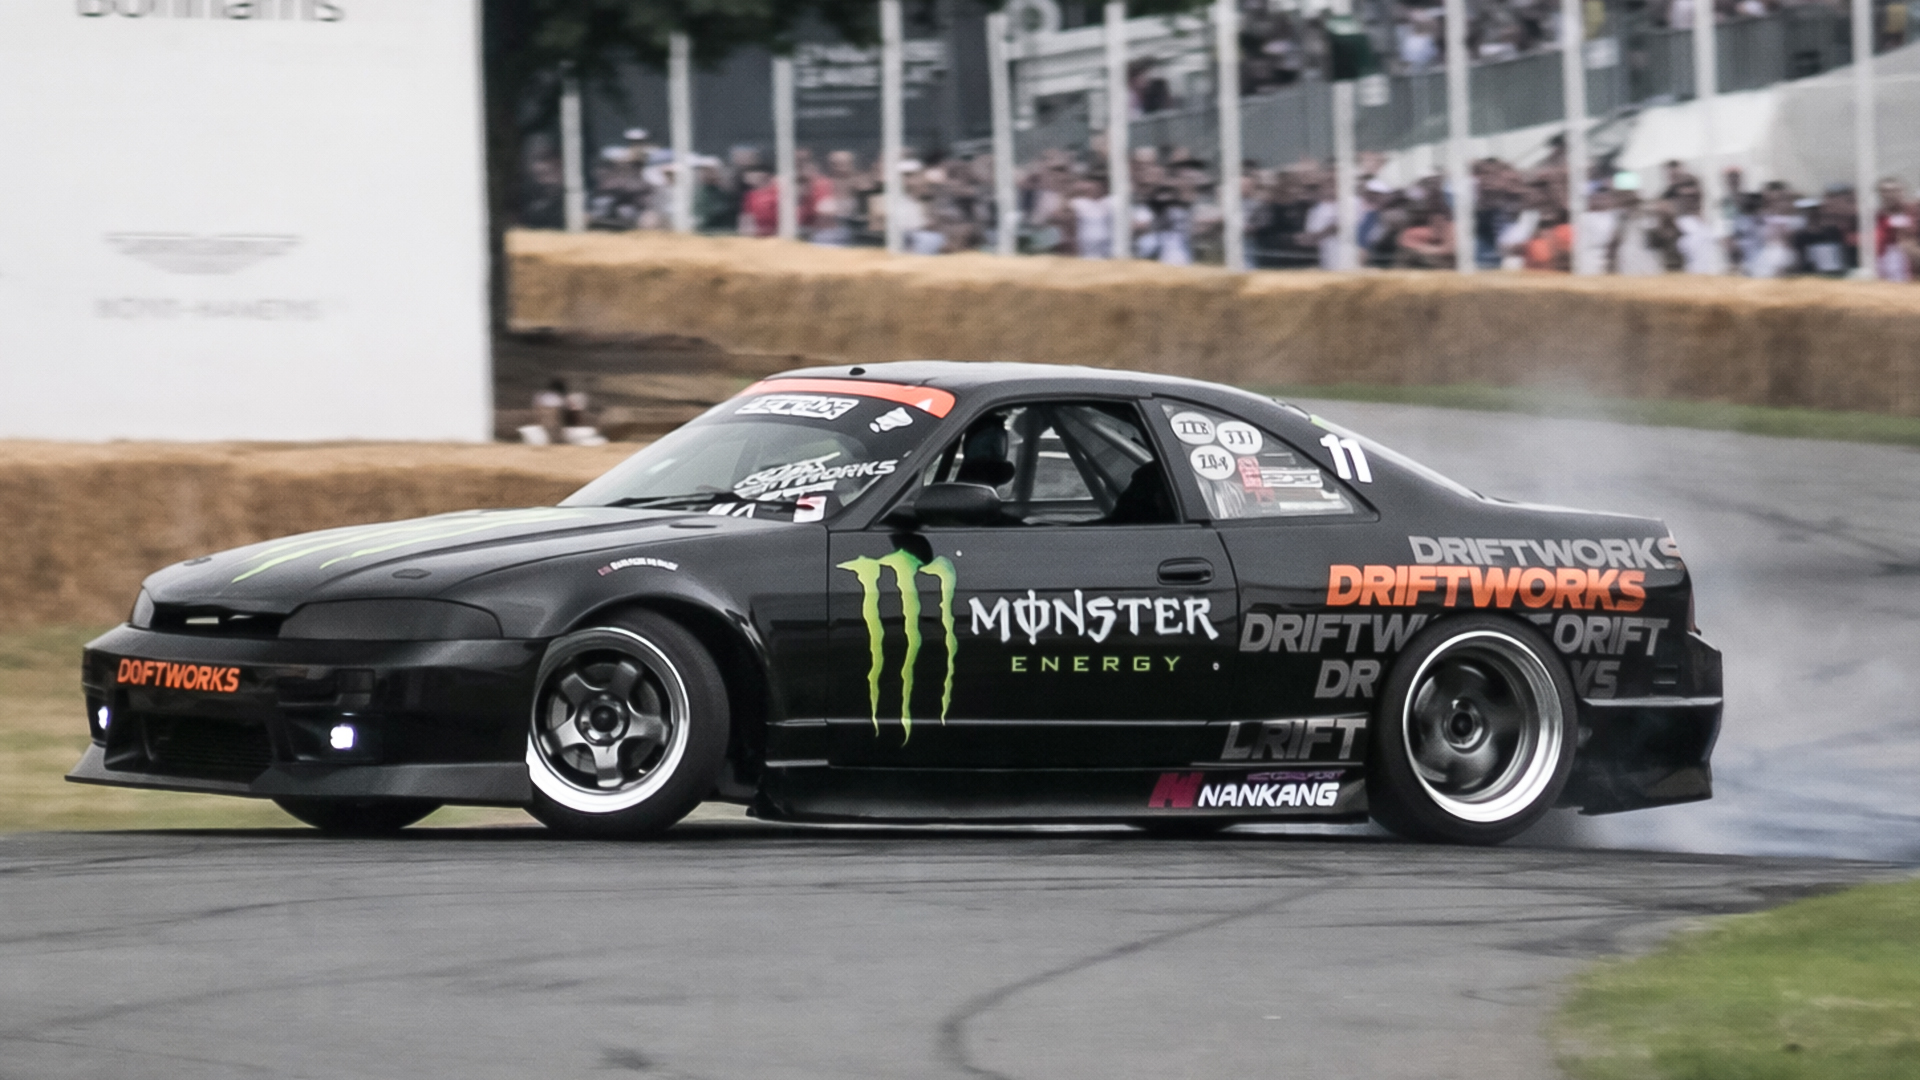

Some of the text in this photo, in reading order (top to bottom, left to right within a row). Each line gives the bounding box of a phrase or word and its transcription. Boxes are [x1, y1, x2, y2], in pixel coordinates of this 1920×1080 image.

[1319, 433, 1374, 483] 11
[1408, 535, 1684, 571] DRIFTWORKS
[1326, 565, 1647, 612] DRIFTWORKS
[968, 588, 1220, 645] MONSTER
[1011, 656, 1181, 673] ENERGY
[1197, 782, 1340, 808] NANKANG
